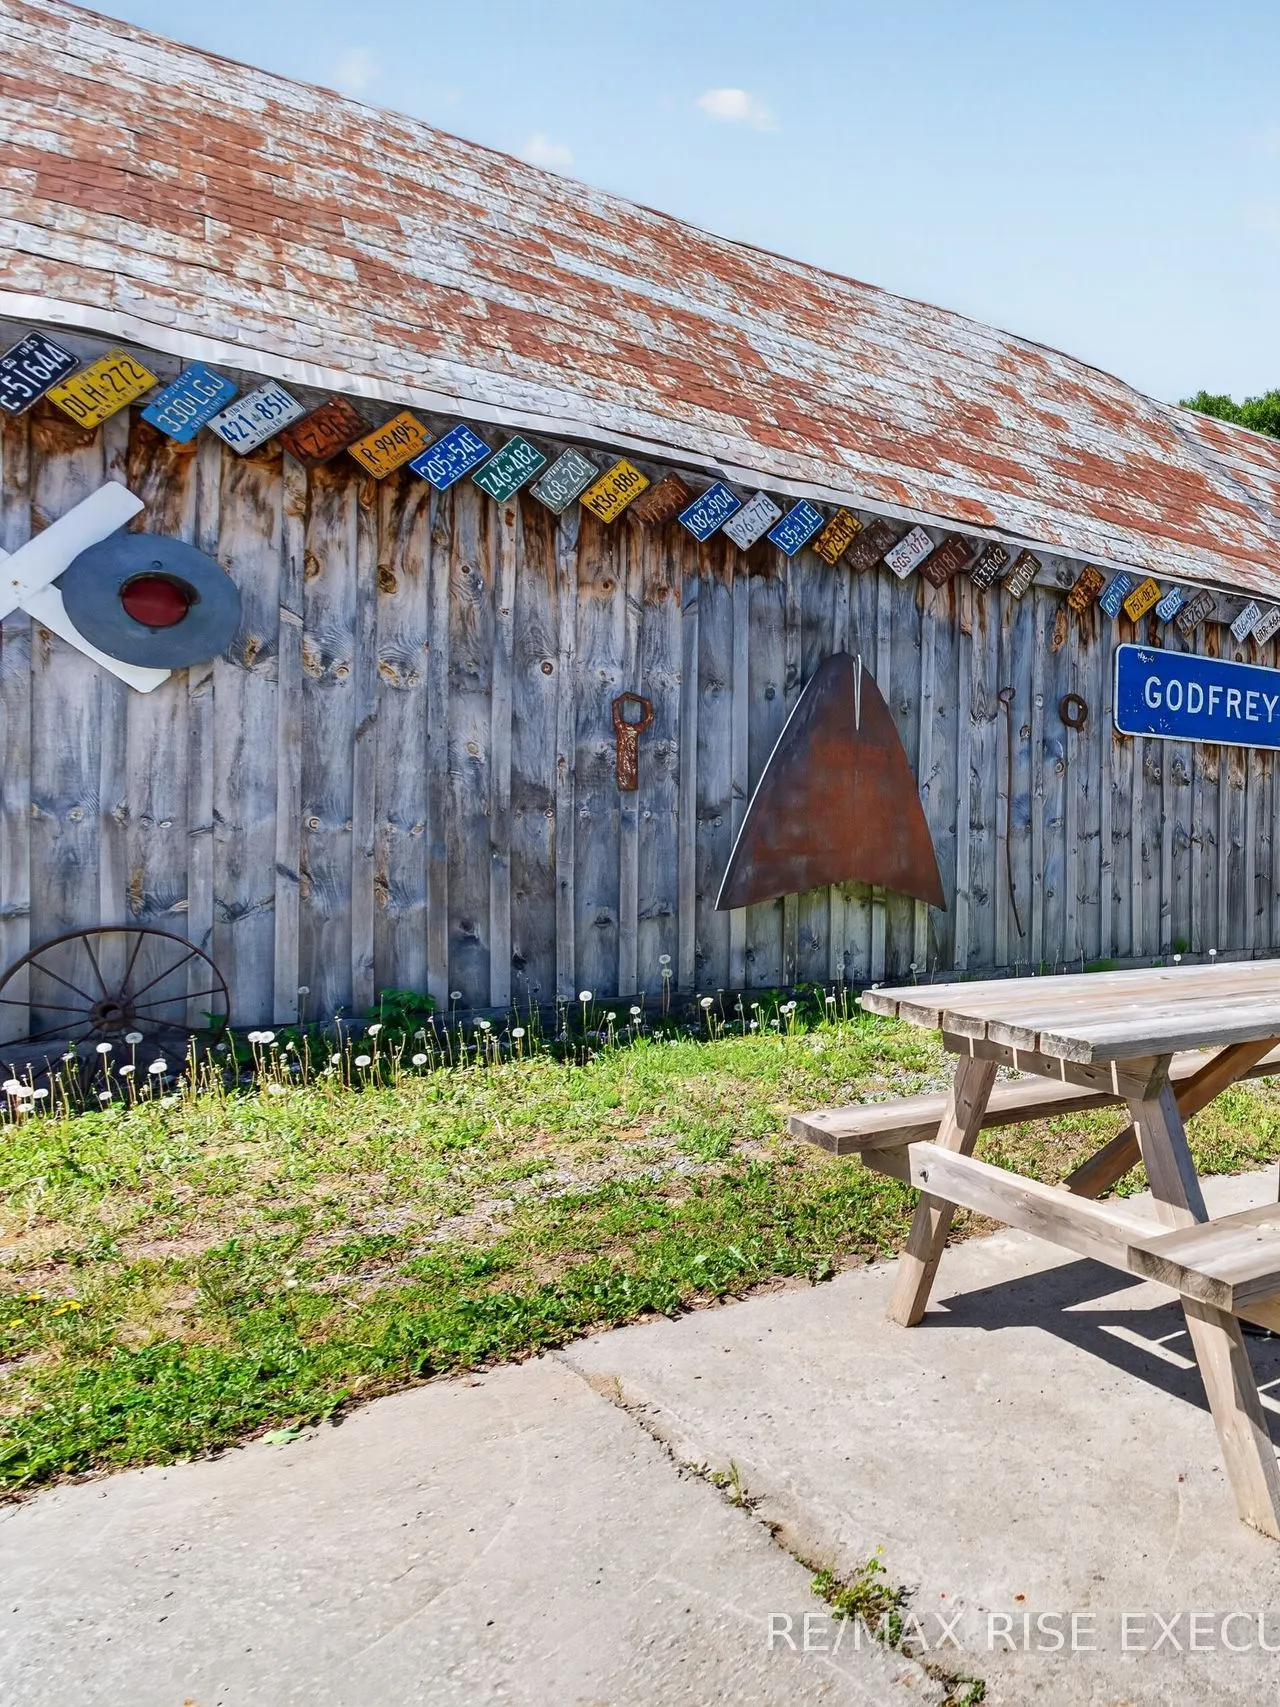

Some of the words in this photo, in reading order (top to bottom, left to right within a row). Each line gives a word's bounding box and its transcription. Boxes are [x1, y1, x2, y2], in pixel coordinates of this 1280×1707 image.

[448, 454, 477, 478] ONTARIO
[506, 465, 533, 491] ONTARIO
[1145, 676, 1279, 723] GODFREY
